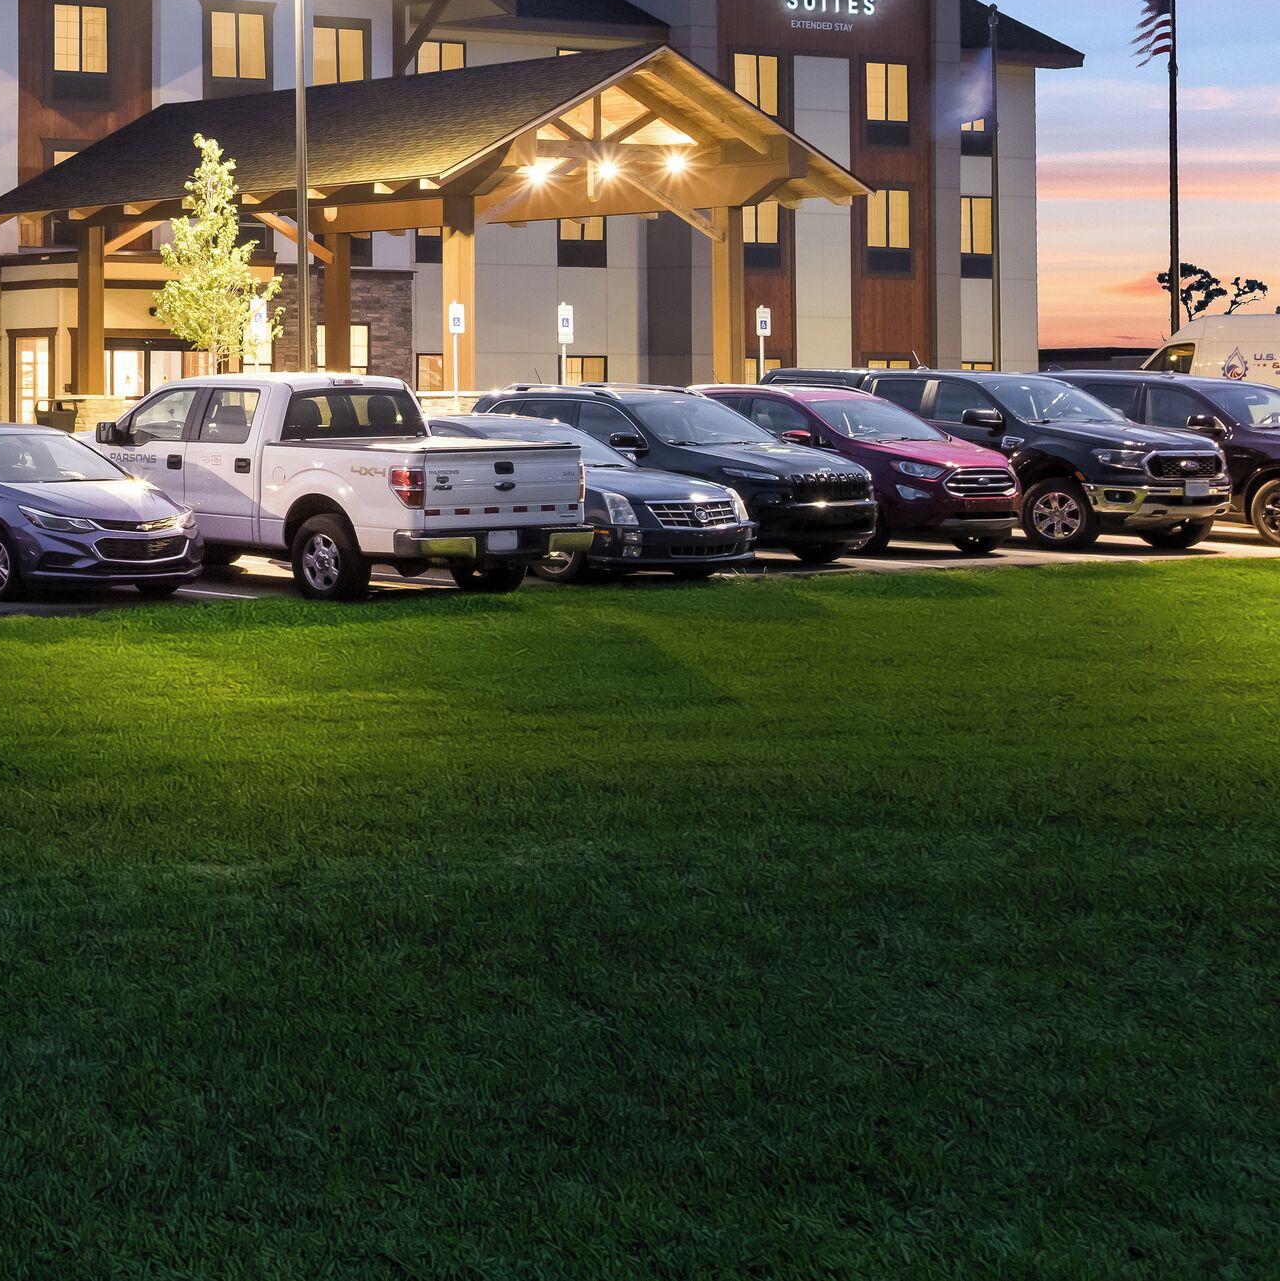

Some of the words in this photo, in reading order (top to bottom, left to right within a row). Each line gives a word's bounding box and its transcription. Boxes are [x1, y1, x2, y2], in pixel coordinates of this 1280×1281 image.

[790, 20, 833, 31] EXTENDED
[834, 21, 854, 32] STAY
[1253, 353, 1277, 361] U.S.
[109, 452, 157, 464] PARSONS
